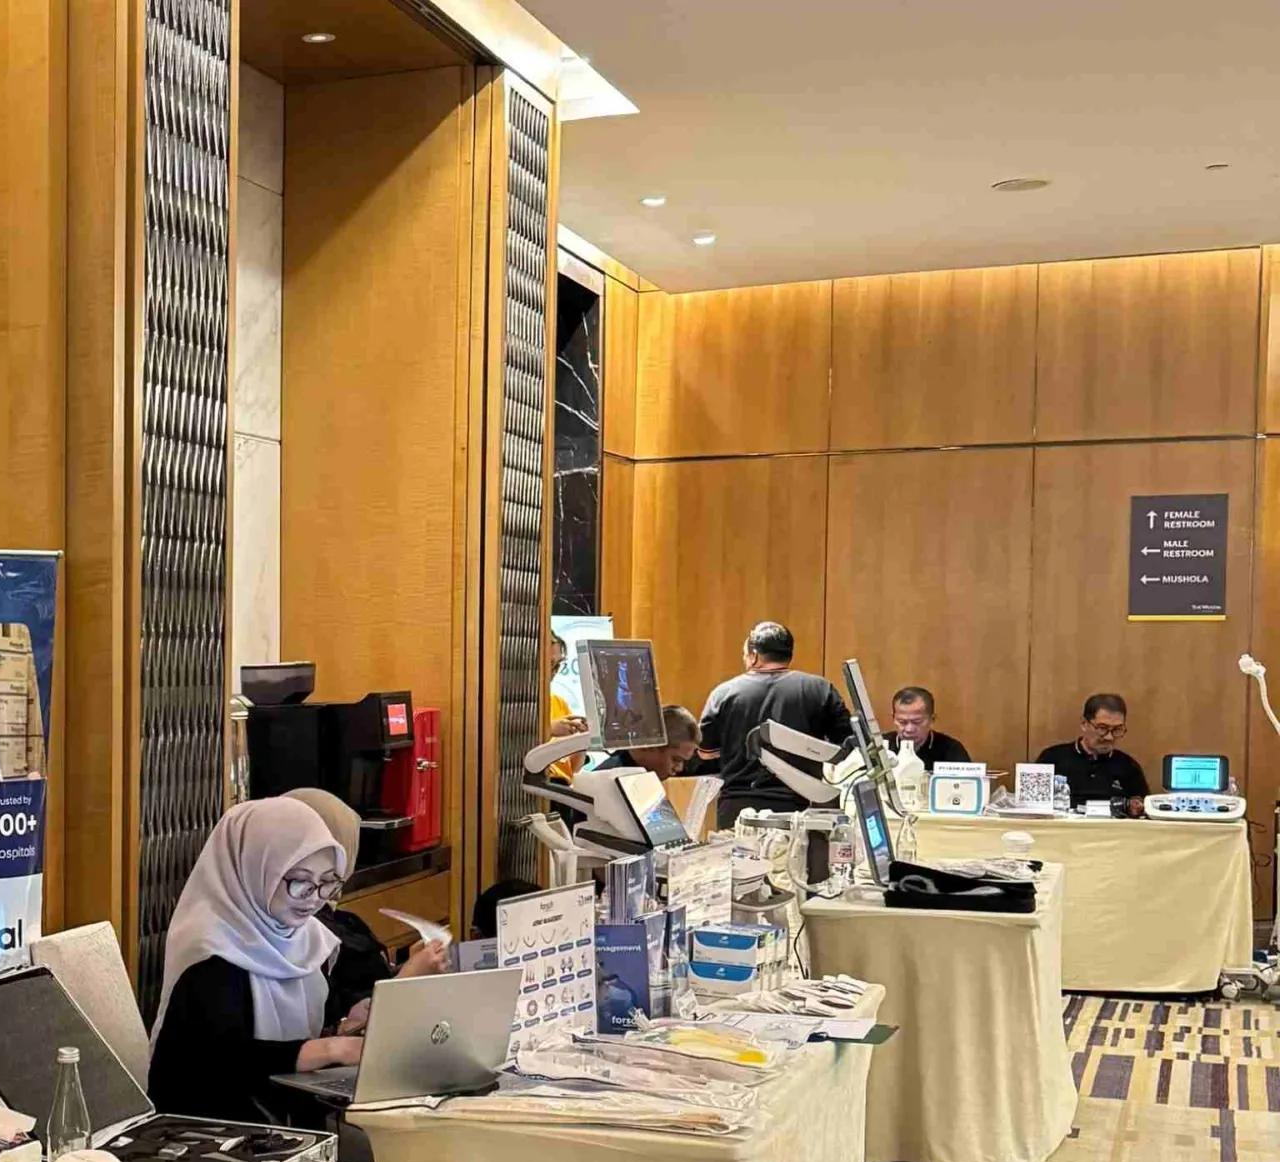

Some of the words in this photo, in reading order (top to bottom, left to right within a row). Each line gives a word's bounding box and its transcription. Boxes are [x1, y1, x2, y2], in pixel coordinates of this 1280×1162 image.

[1164, 510, 1200, 519] FEMALE
[1164, 520, 1215, 529] RESTROOM
[1163, 540, 1189, 548] MALE
[1163, 549, 1214, 558] RESTROOM
[1162, 575, 1209, 583] MUSHOLA
[23, 795, 32, 806] by
[595, 944, 642, 953] anagement
